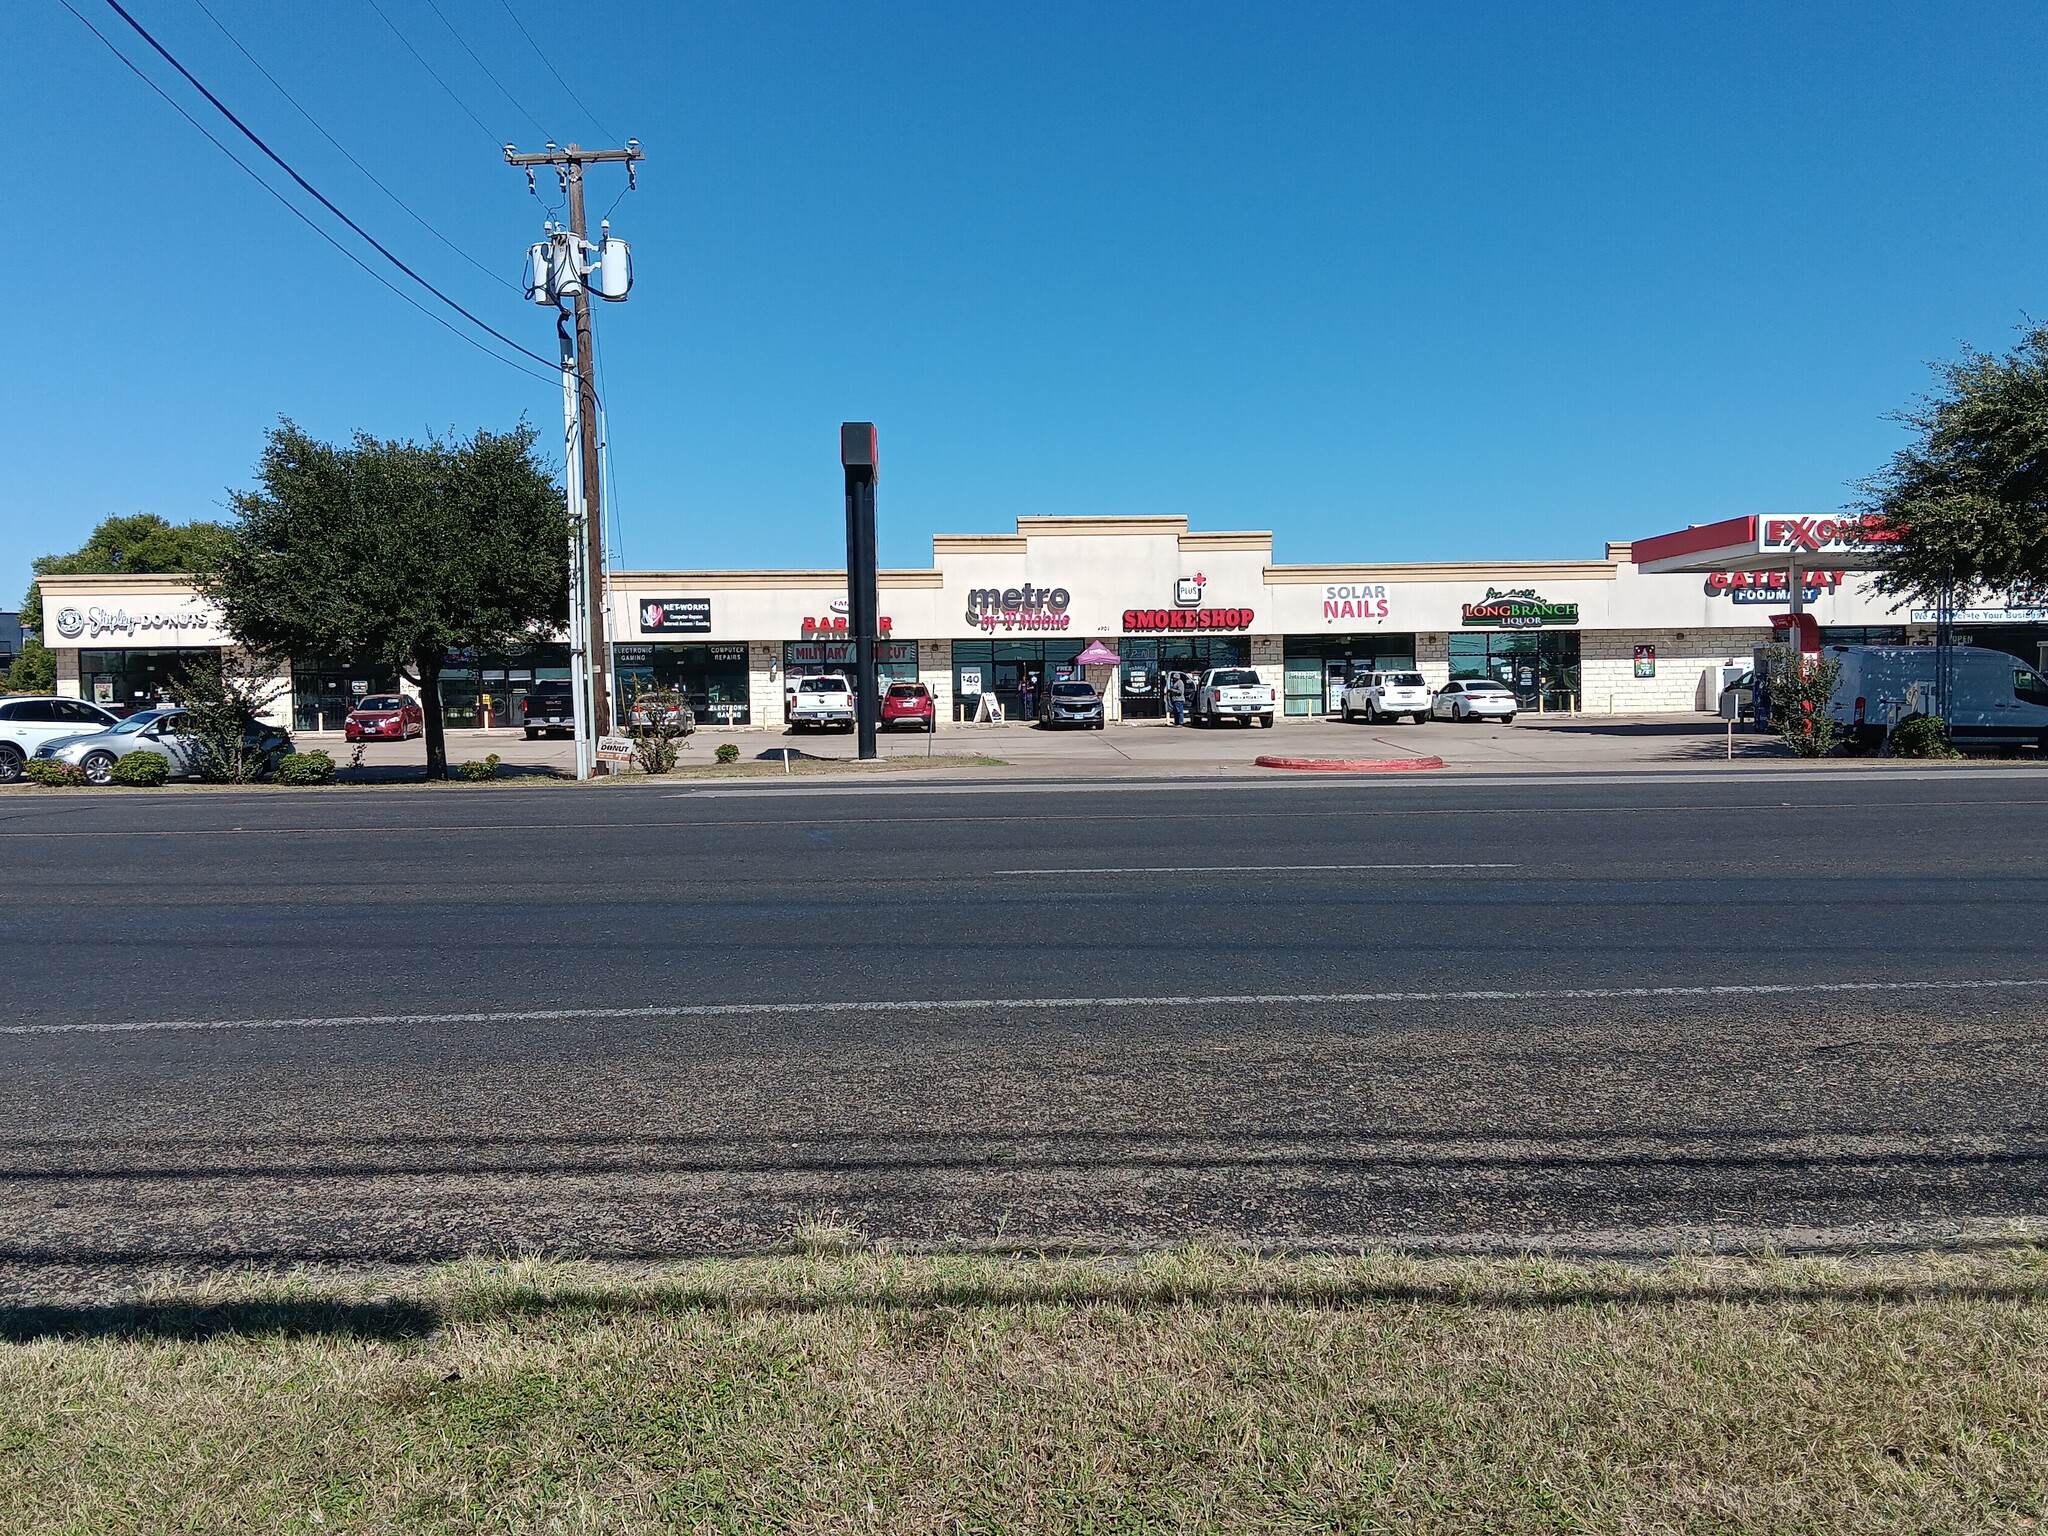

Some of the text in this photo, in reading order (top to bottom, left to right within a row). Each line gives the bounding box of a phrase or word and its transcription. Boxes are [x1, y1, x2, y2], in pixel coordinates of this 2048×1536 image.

[970, 583, 1070, 609] metro
[1326, 585, 1386, 600] SOLAR
[1323, 599, 1389, 619] NAILS
[1983, 611, 2003, 619] Your
[88, 606, 134, 633] Shipley
[803, 617, 893, 631] BARR
[1123, 608, 1254, 629] SMOKE SHOP
[1501, 616, 1542, 625] LIQUOR
[795, 647, 848, 660] MILITARY
